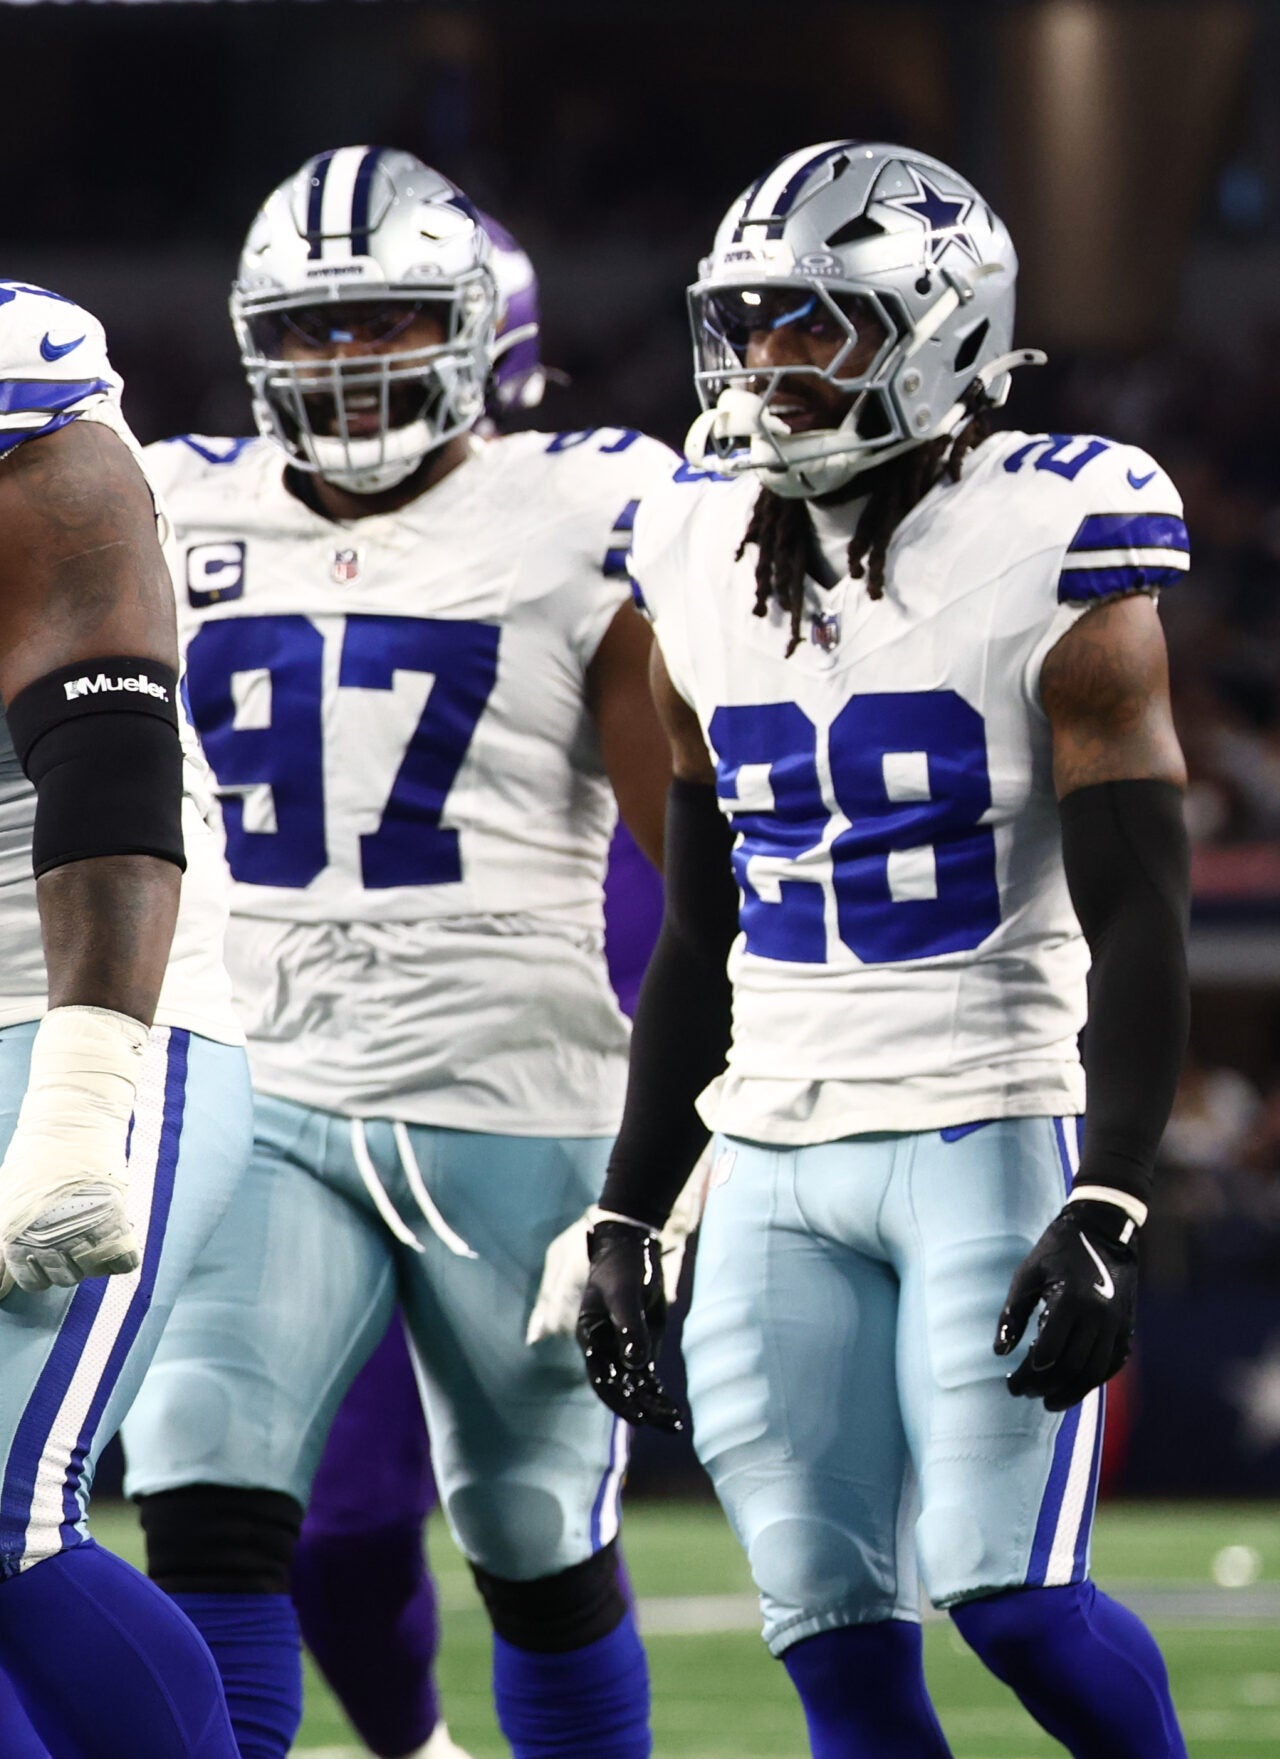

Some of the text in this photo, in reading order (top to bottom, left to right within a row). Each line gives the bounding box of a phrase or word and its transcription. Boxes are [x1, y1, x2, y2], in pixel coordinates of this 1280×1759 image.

[188, 543, 242, 593] C
[186, 613, 502, 890] 97
[707, 689, 1002, 964] 28
